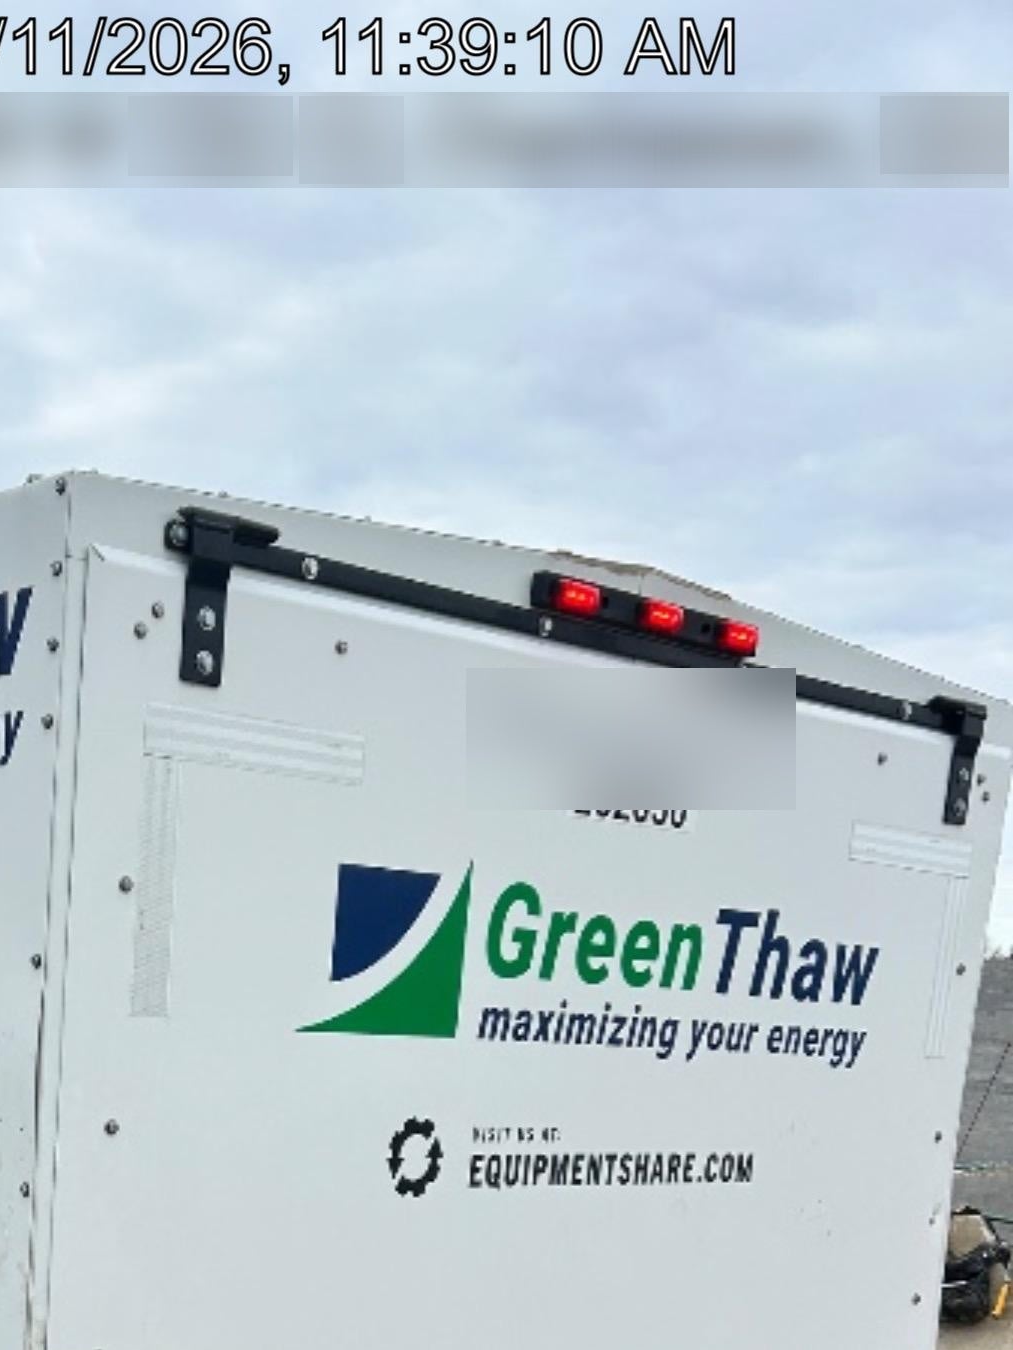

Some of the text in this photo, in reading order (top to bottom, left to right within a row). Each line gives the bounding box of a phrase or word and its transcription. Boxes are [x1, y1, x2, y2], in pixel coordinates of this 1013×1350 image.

[477, 999, 868, 1068] maximizing your energy
[468, 1152, 754, 1190] EQUIPMENTSHARE.COM
